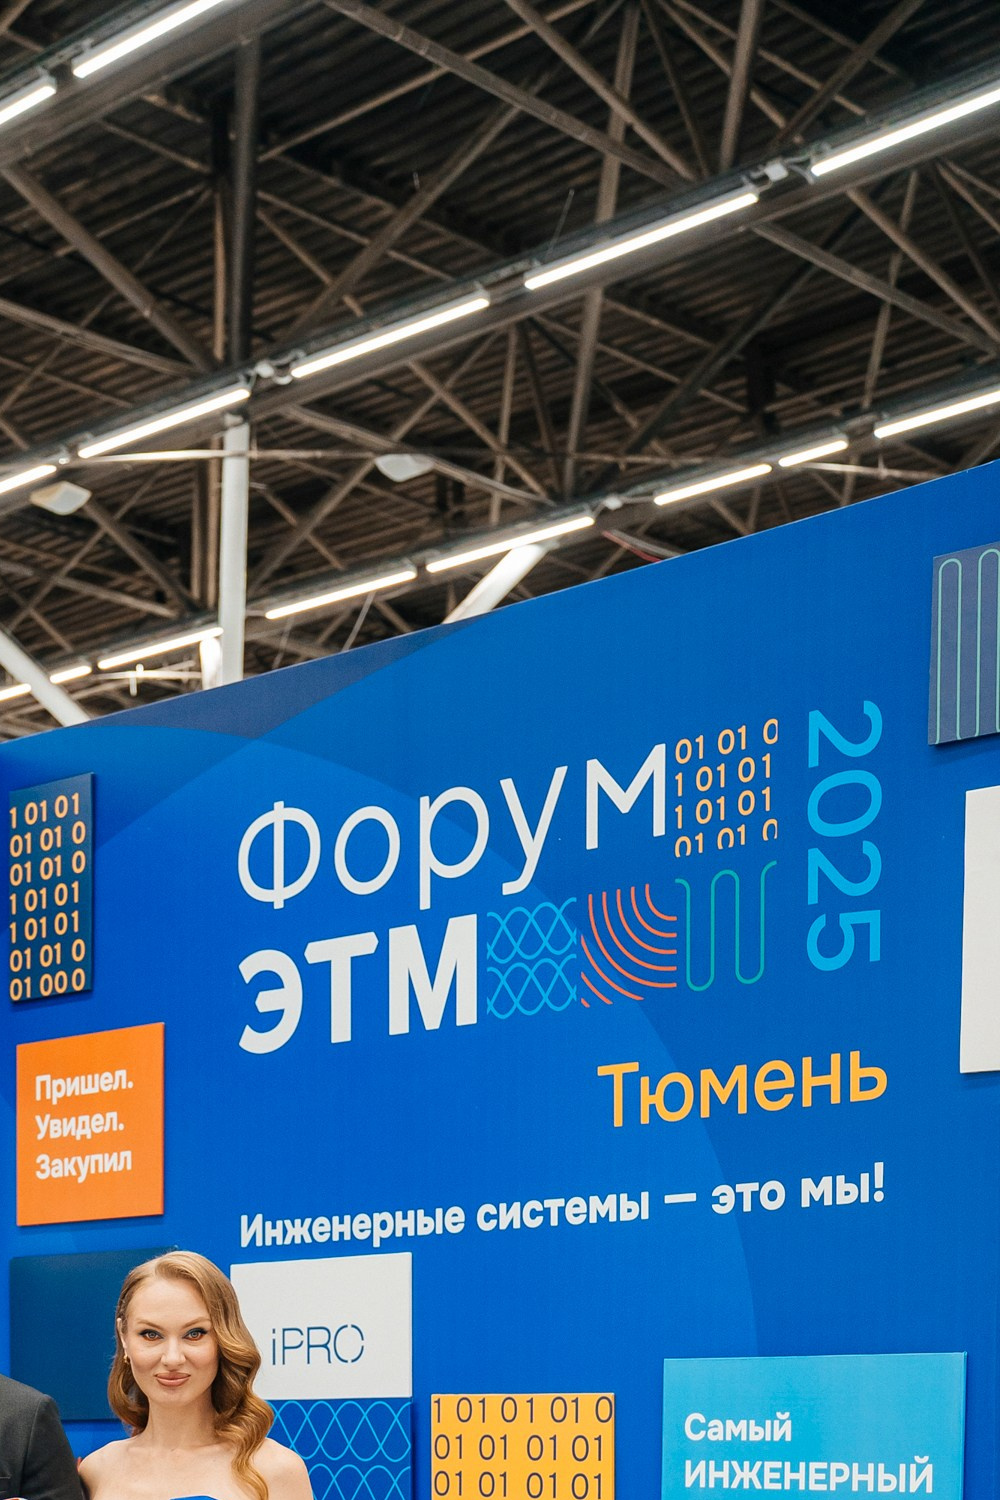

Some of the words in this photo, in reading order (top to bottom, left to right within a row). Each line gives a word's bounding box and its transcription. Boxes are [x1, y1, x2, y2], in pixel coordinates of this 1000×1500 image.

[238, 743, 666, 909] Форум
[806, 700, 883, 972] 2025
[238, 913, 478, 1054] ЭТМ
[35, 1069, 134, 1105] Пришел.
[597, 1050, 888, 1128] Тюмень
[35, 1111, 125, 1141] Увидел.
[36, 1150, 132, 1184] Закупил
[240, 1206, 465, 1248] Инженерные
[476, 1191, 649, 1232] системы
[711, 1180, 786, 1215] это
[801, 1161, 884, 1208] мы!
[272, 1324, 364, 1366] iPRO
[684, 1411, 792, 1442] Самый
[684, 1455, 933, 1494] ИНЖЕНЕРНЫЙ
